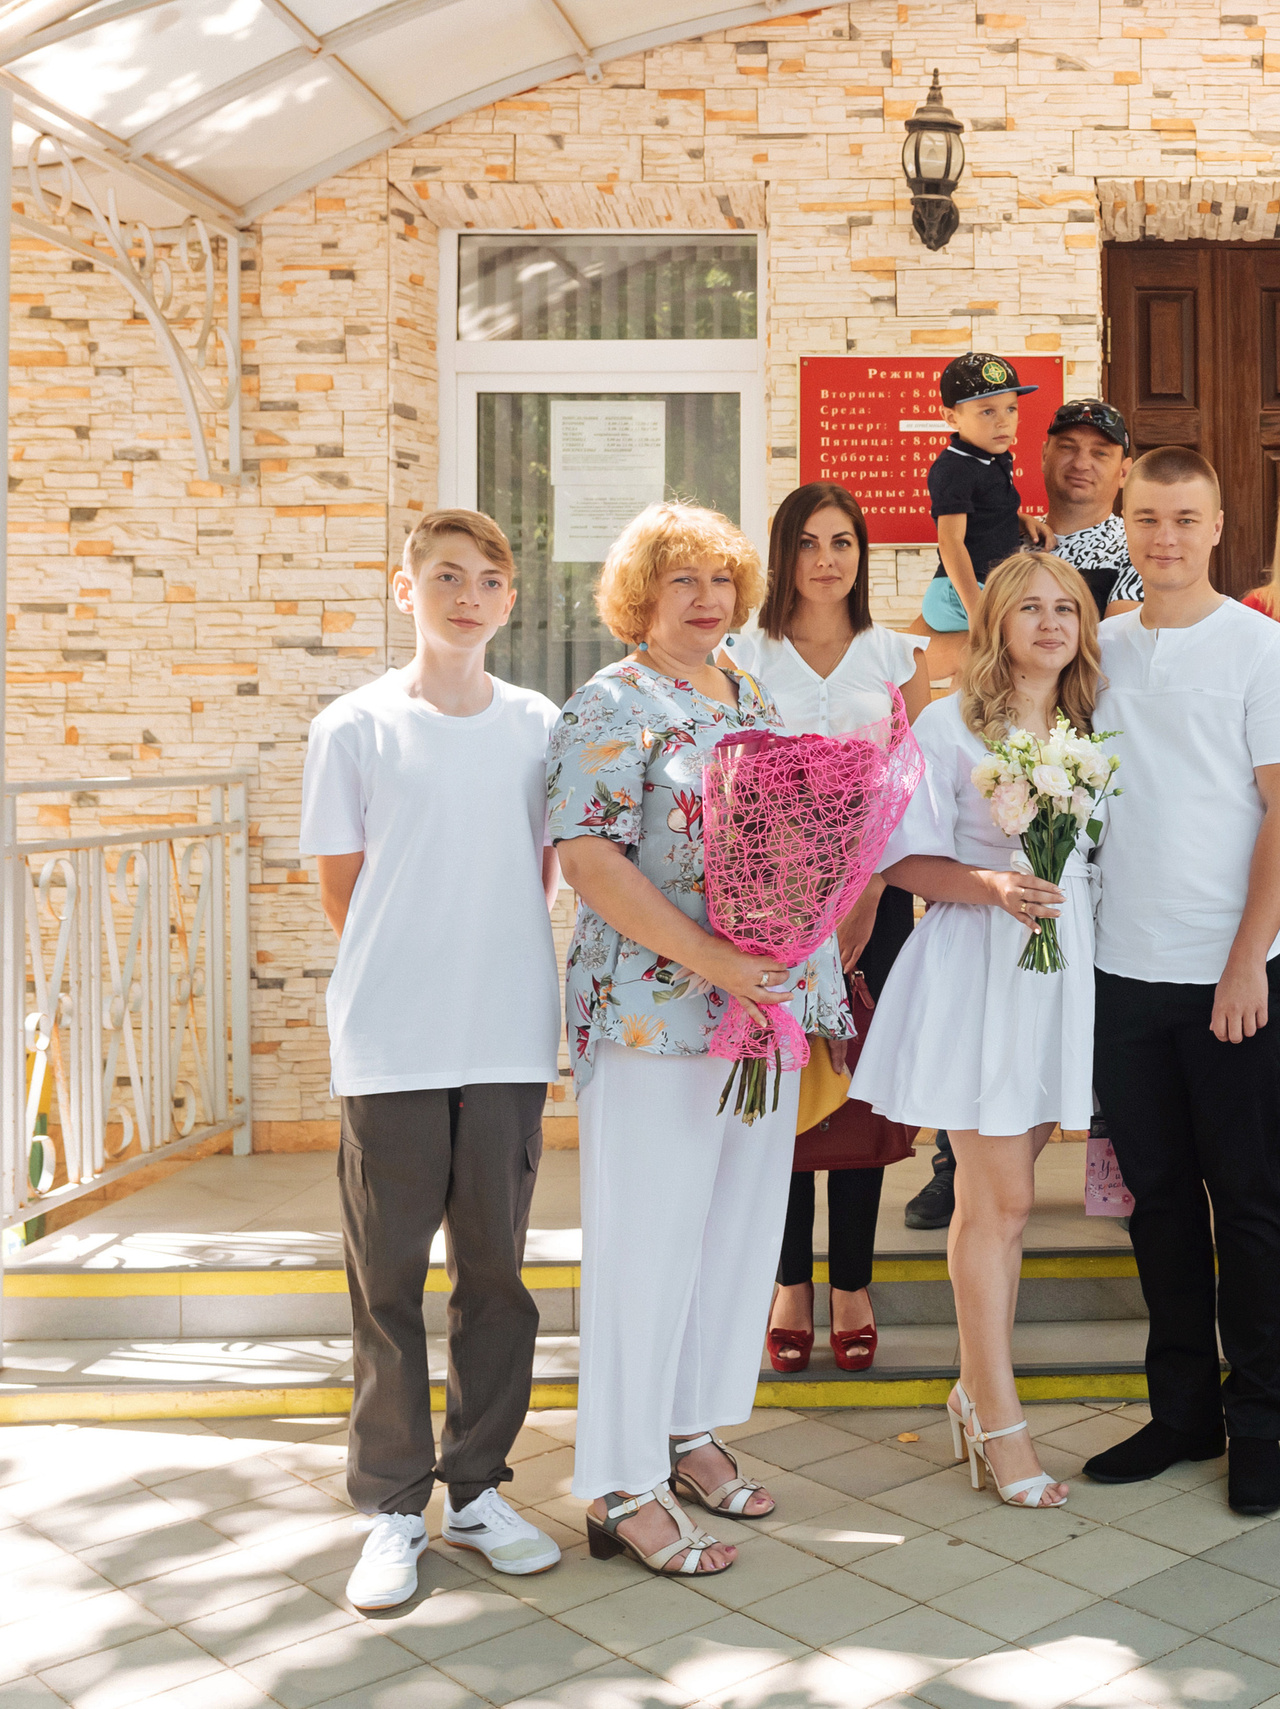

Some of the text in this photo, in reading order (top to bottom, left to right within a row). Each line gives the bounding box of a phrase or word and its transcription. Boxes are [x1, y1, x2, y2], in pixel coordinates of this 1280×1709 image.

[867, 368, 925, 379] Режим
[820, 389, 891, 401] Вторник:
[900, 390, 906, 398] с
[820, 405, 871, 417] Среда:
[900, 406, 906, 414] с
[820, 421, 887, 432] Четверг:
[820, 436, 947, 447] Пятница: с 8.00
[820, 452, 889, 465] Суббота:
[913, 452, 937, 462] 8.0
[820, 469, 894, 480] Перерыв:
[900, 470, 907, 478] с
